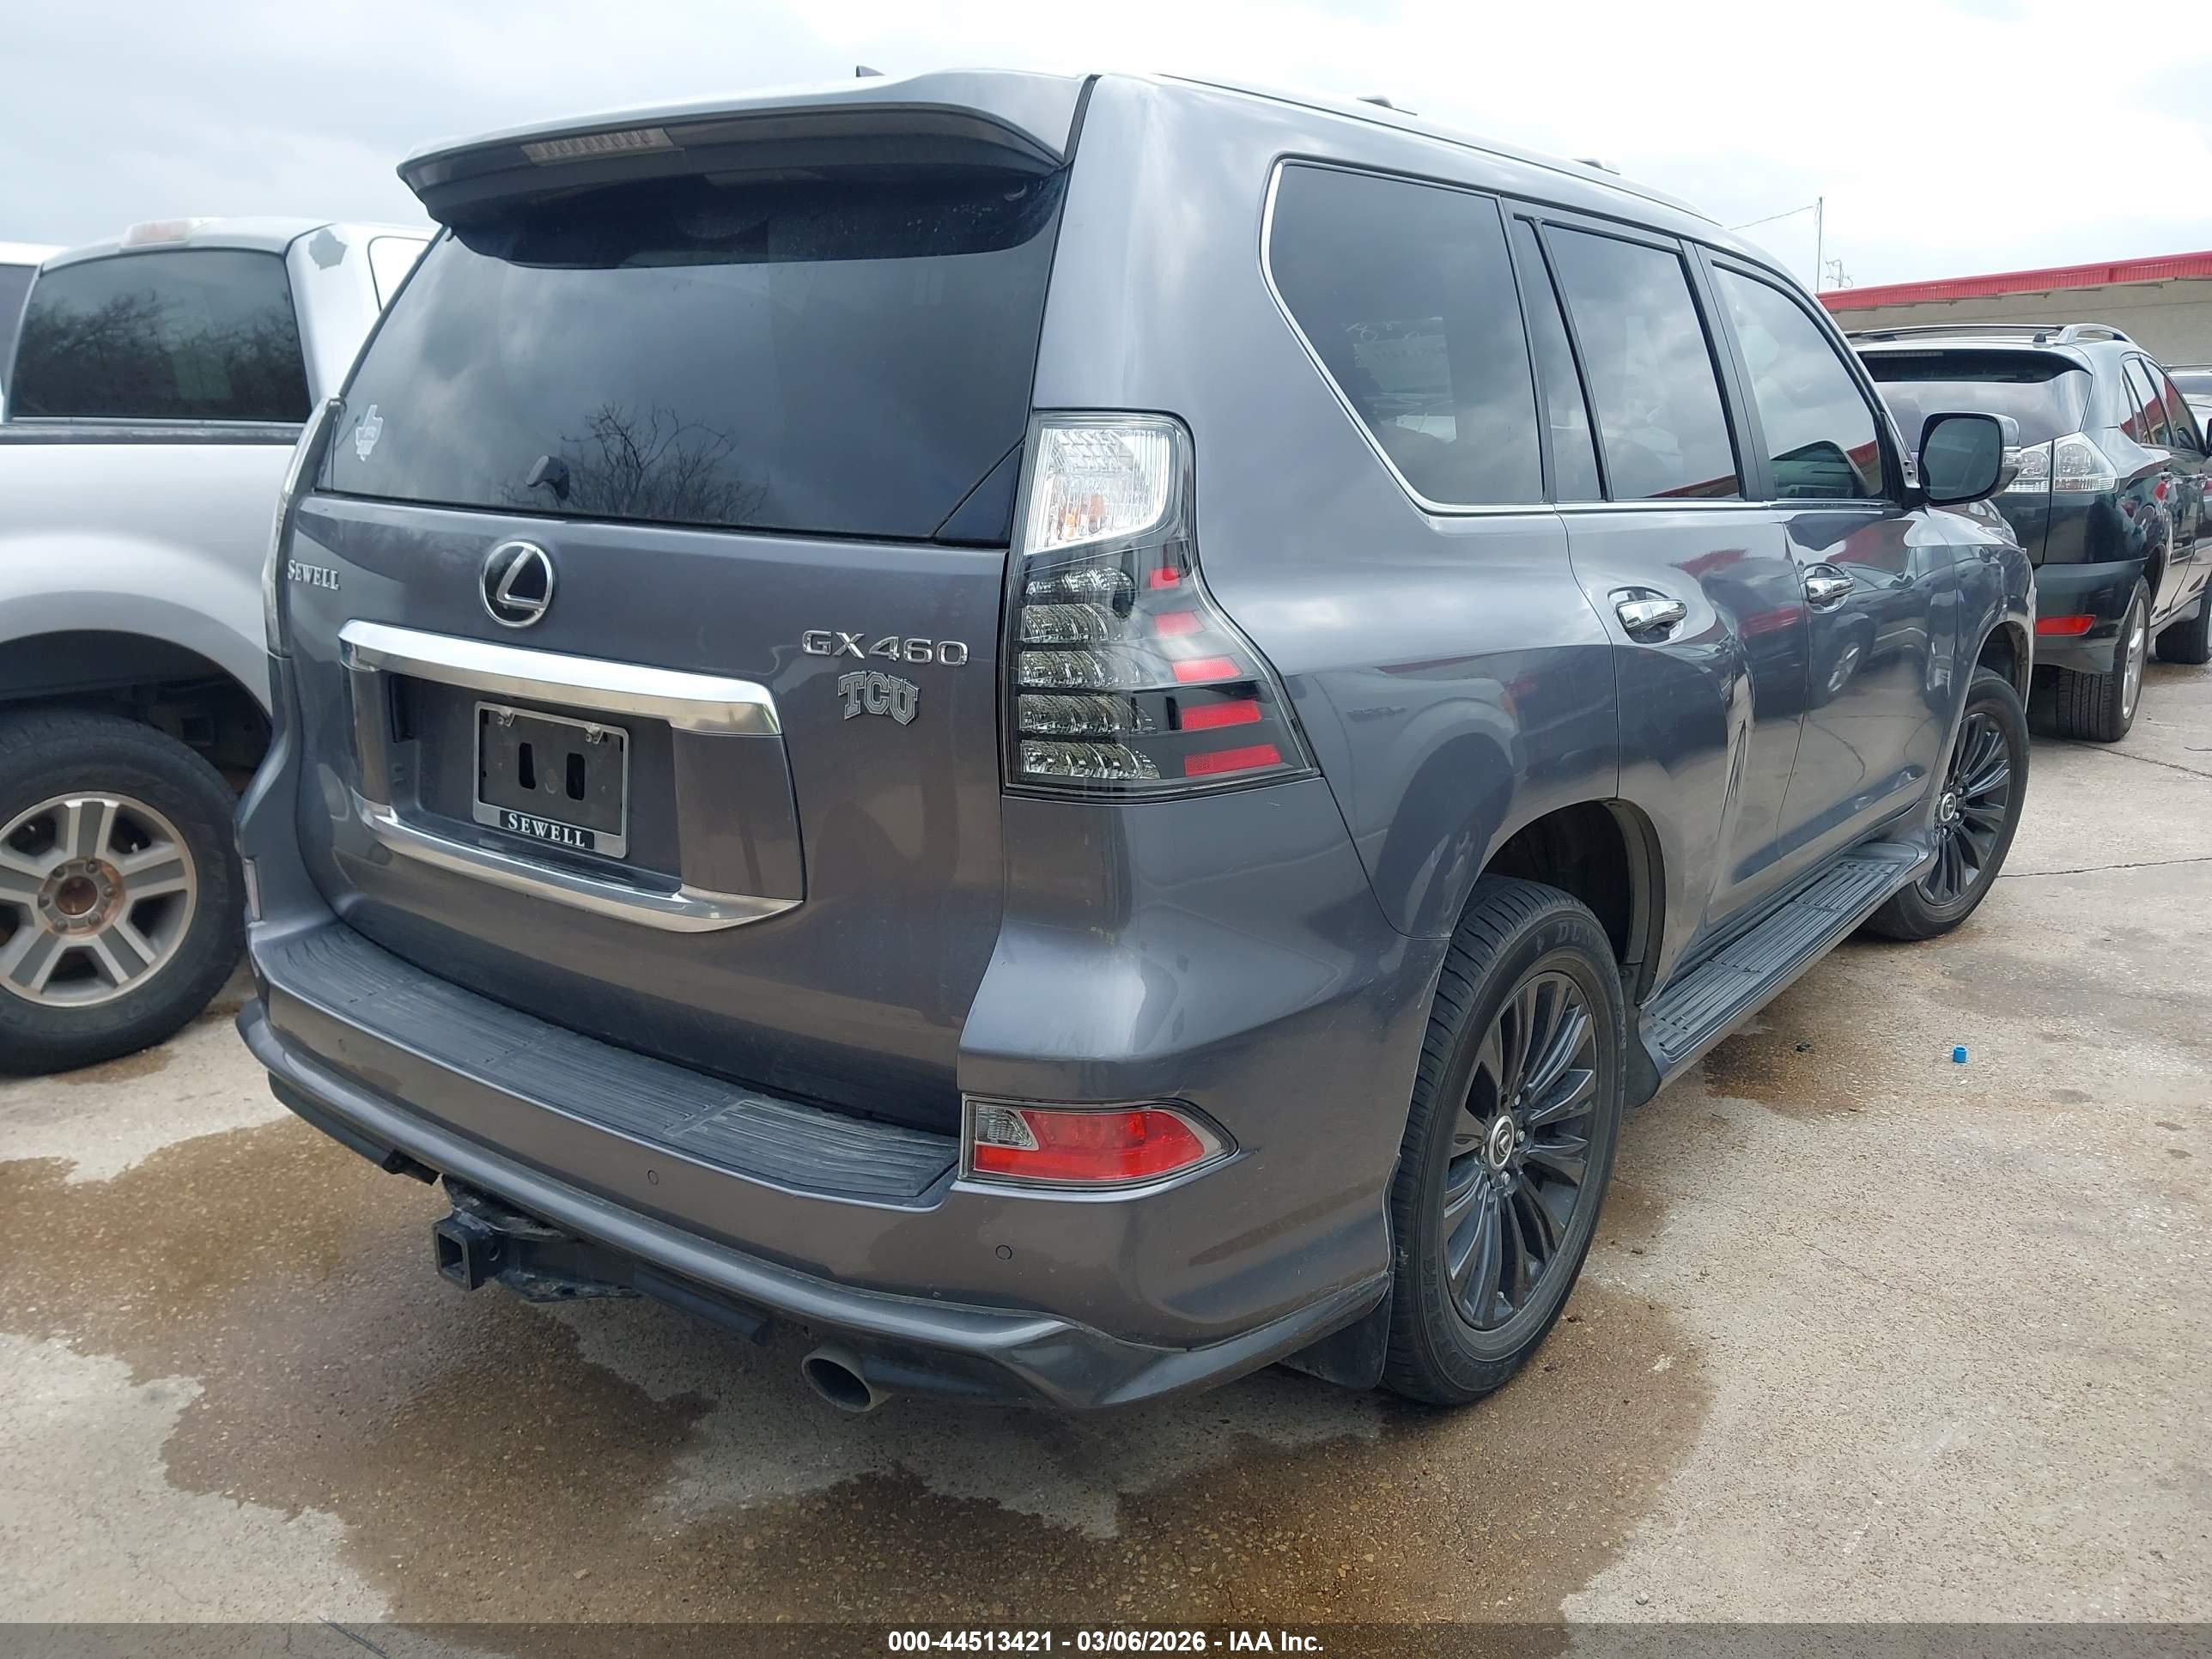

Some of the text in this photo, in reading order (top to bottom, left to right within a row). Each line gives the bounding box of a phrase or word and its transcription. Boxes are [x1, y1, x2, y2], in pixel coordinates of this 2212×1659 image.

[287, 559, 340, 591] SEWELL
[837, 670, 921, 726] TCU
[507, 812, 586, 847] SEWELL
